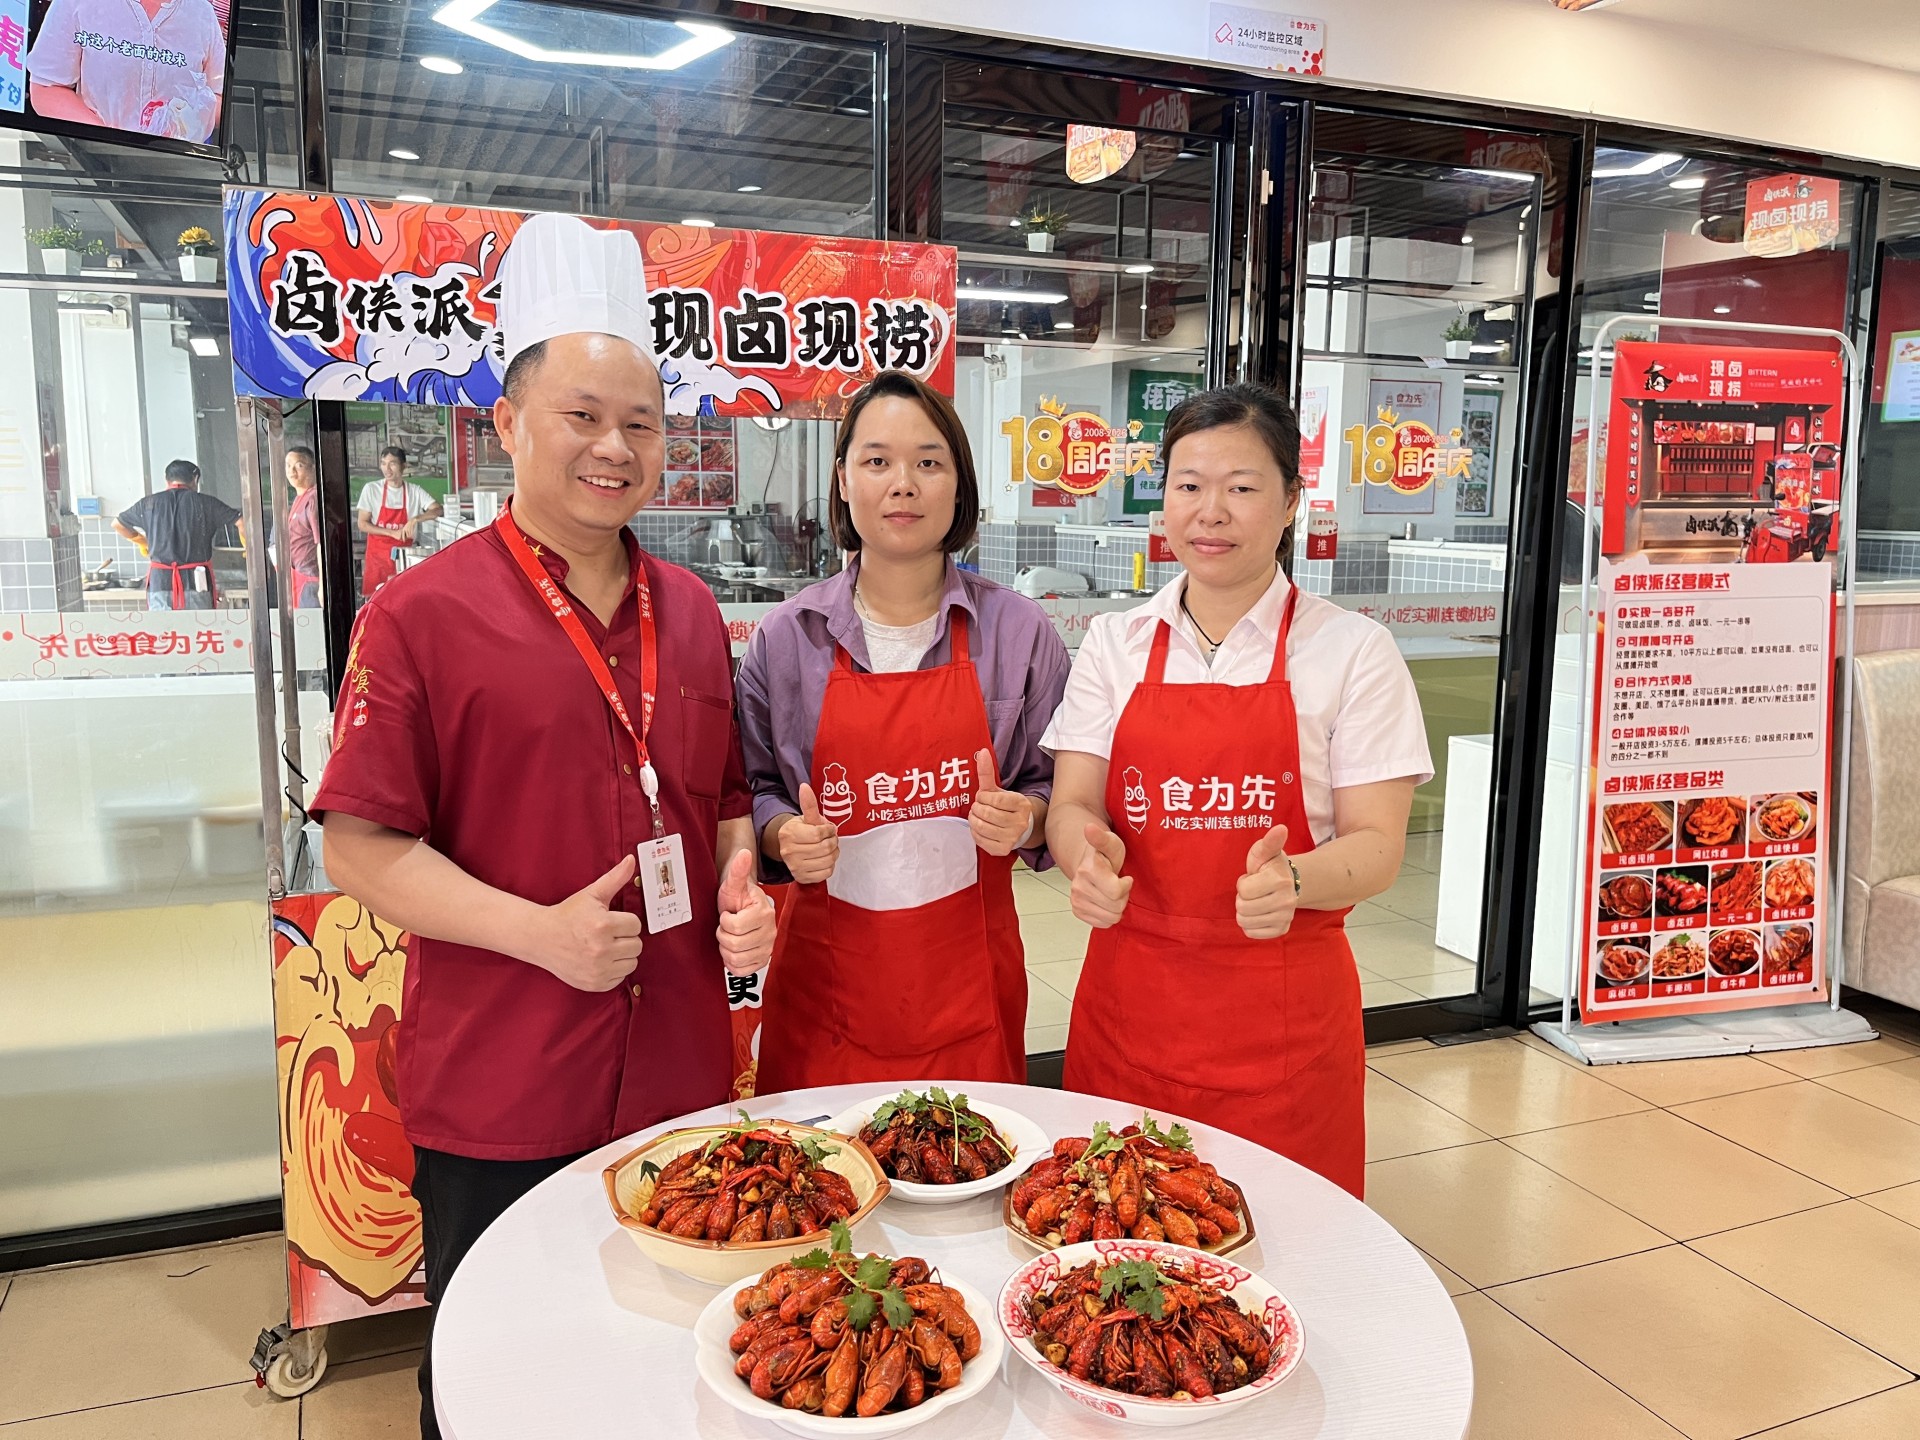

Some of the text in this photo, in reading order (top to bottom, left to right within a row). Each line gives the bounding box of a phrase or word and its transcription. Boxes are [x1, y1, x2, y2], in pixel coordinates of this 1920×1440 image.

[1237, 27, 1303, 46] 24小时监控区域
[74, 31, 187, 67] 对这个老面的技术
[1752, 199, 1828, 231] 现卤现捞
[274, 254, 934, 371] 卤侠派 现卤现捞
[1710, 360, 1742, 377] 现卤
[1709, 380, 1741, 397] 现捞
[1001, 416, 1155, 483] 18 周年庆
[1344, 424, 1472, 485] 18 周年庆
[1317, 538, 1327, 551] 推
[1614, 573, 1730, 591] 卤侠派经营模式
[865, 757, 970, 805] 食为先
[1604, 770, 1724, 793] 卤侠派经营品类
[1160, 774, 1276, 811] 食为先
[866, 792, 970, 823] 小吃实训连锁机构
[1159, 814, 1273, 830] 小吃实训连锁机构
[1692, 848, 1728, 860] 网红炸卤
[1765, 843, 1799, 854] 卤味快餐
[1618, 853, 1655, 865] 现卤现捞
[1667, 917, 1694, 928] 卤龙虾
[1718, 912, 1753, 923] 一元一串
[1611, 921, 1638, 933] 卤甲鱼
